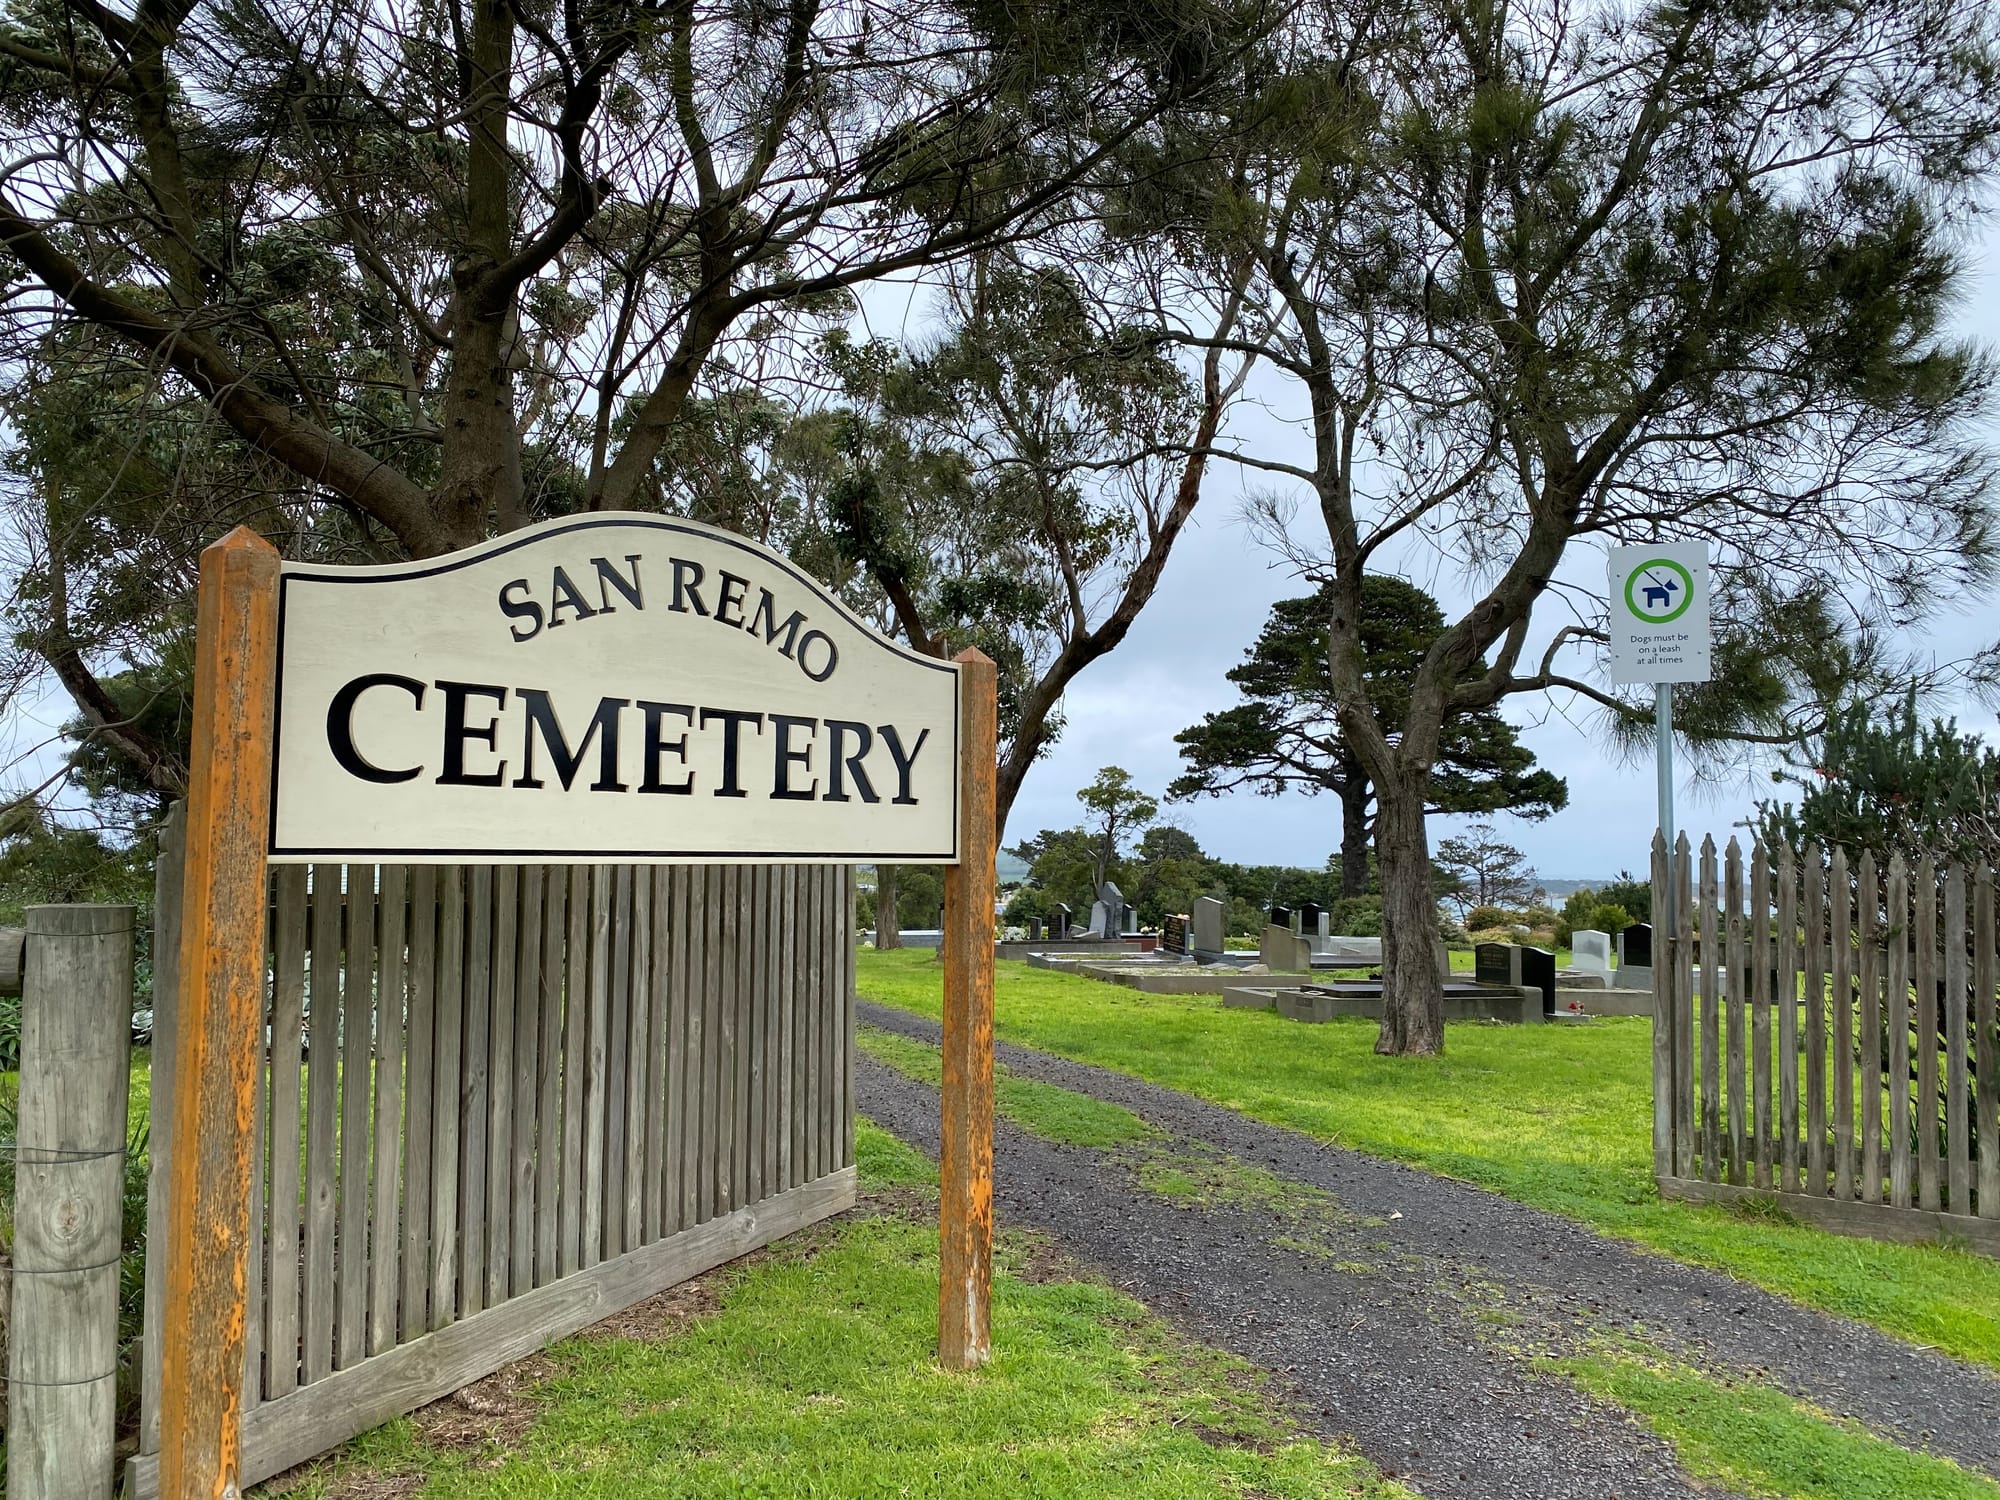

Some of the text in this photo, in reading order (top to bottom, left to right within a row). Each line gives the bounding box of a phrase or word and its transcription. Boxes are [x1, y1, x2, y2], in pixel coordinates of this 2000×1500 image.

[499, 554, 840, 683] SAN REMO
[1630, 633, 1689, 644] Dogs must be
[1659, 644, 1681, 653] leash
[1637, 656, 1683, 665] at all times
[326, 672, 931, 806] CEMETERY
